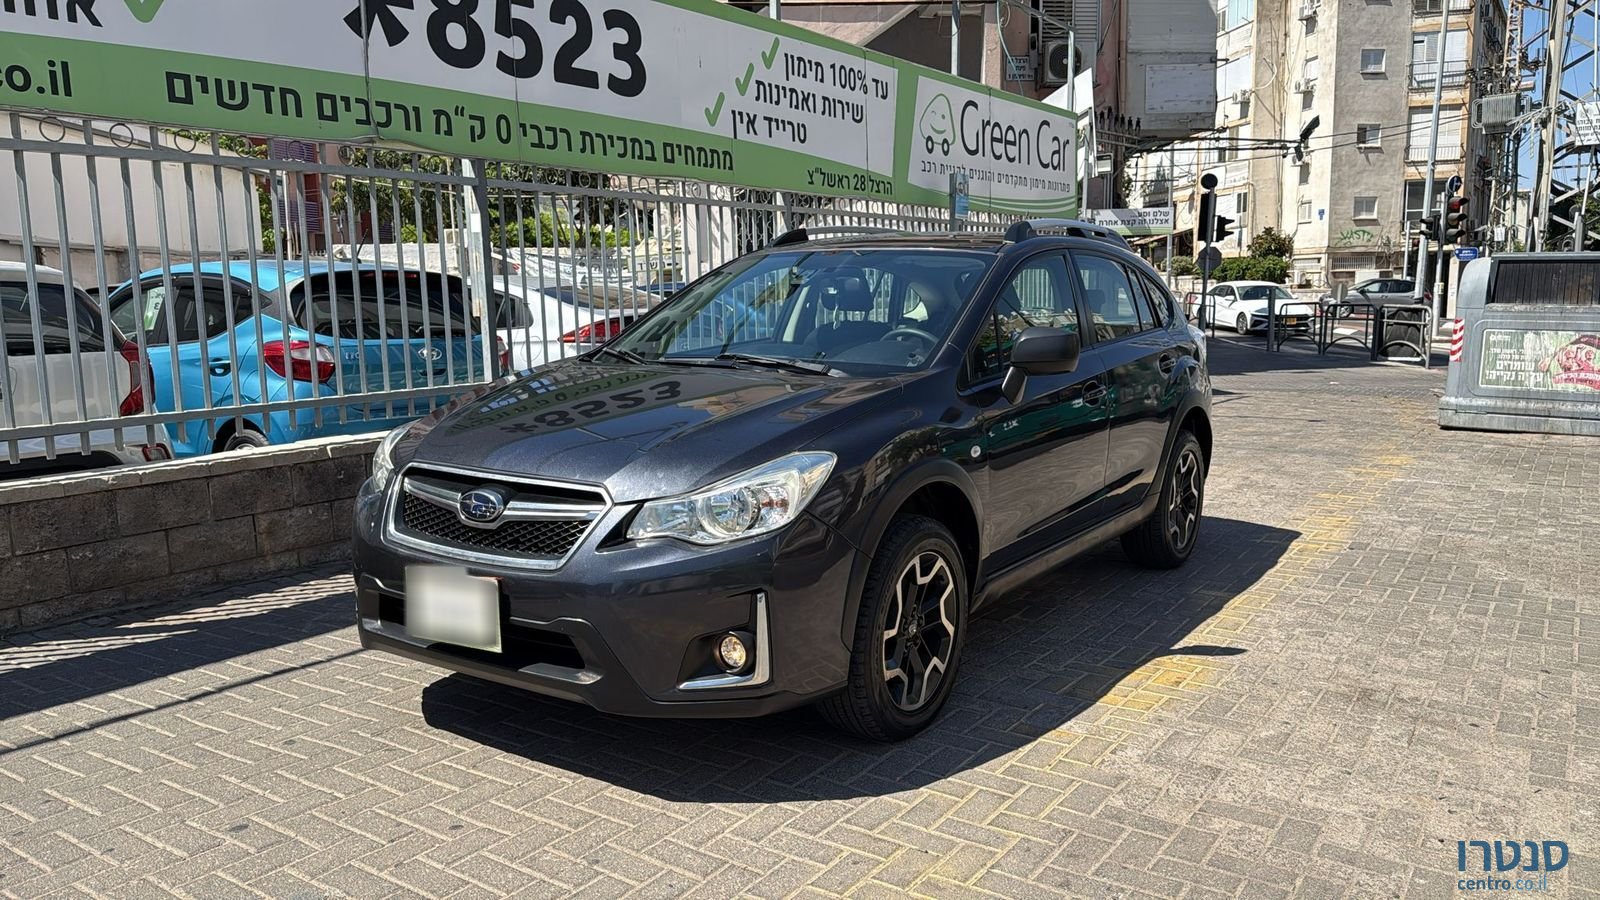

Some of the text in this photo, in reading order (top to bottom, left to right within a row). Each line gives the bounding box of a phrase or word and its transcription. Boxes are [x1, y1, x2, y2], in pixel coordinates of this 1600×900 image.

[784, 52, 889, 100] עד 100% מימון
[165, 71, 303, 118] חדשים
[755, 79, 864, 124] שירות ואמינות
[315, 91, 422, 133] ורכבים
[495, 113, 512, 145] 0
[519, 122, 573, 152] רכבי
[731, 109, 808, 144] טרייד אין
[960, 99, 1070, 173] Green Car
[580, 129, 657, 163] במכירת
[662, 141, 734, 172] מתמחים
[921, 160, 937, 174] רכב
[969, 167, 995, 182] והוגנים
[997, 174, 1028, 188] מתקדמים
[807, 168, 893, 196] הרצל 28 ראשל"צ
[1029, 178, 1046, 190] מימון
[1047, 180, 1071, 193] פתרונות
[1098, 219, 1119, 227] אחרת
[1120, 219, 1137, 227] קצת
[1148, 217, 1170, 225] אצלנו
[1153, 209, 1170, 217] שלם
[1496, 360, 1535, 371] שומרים
